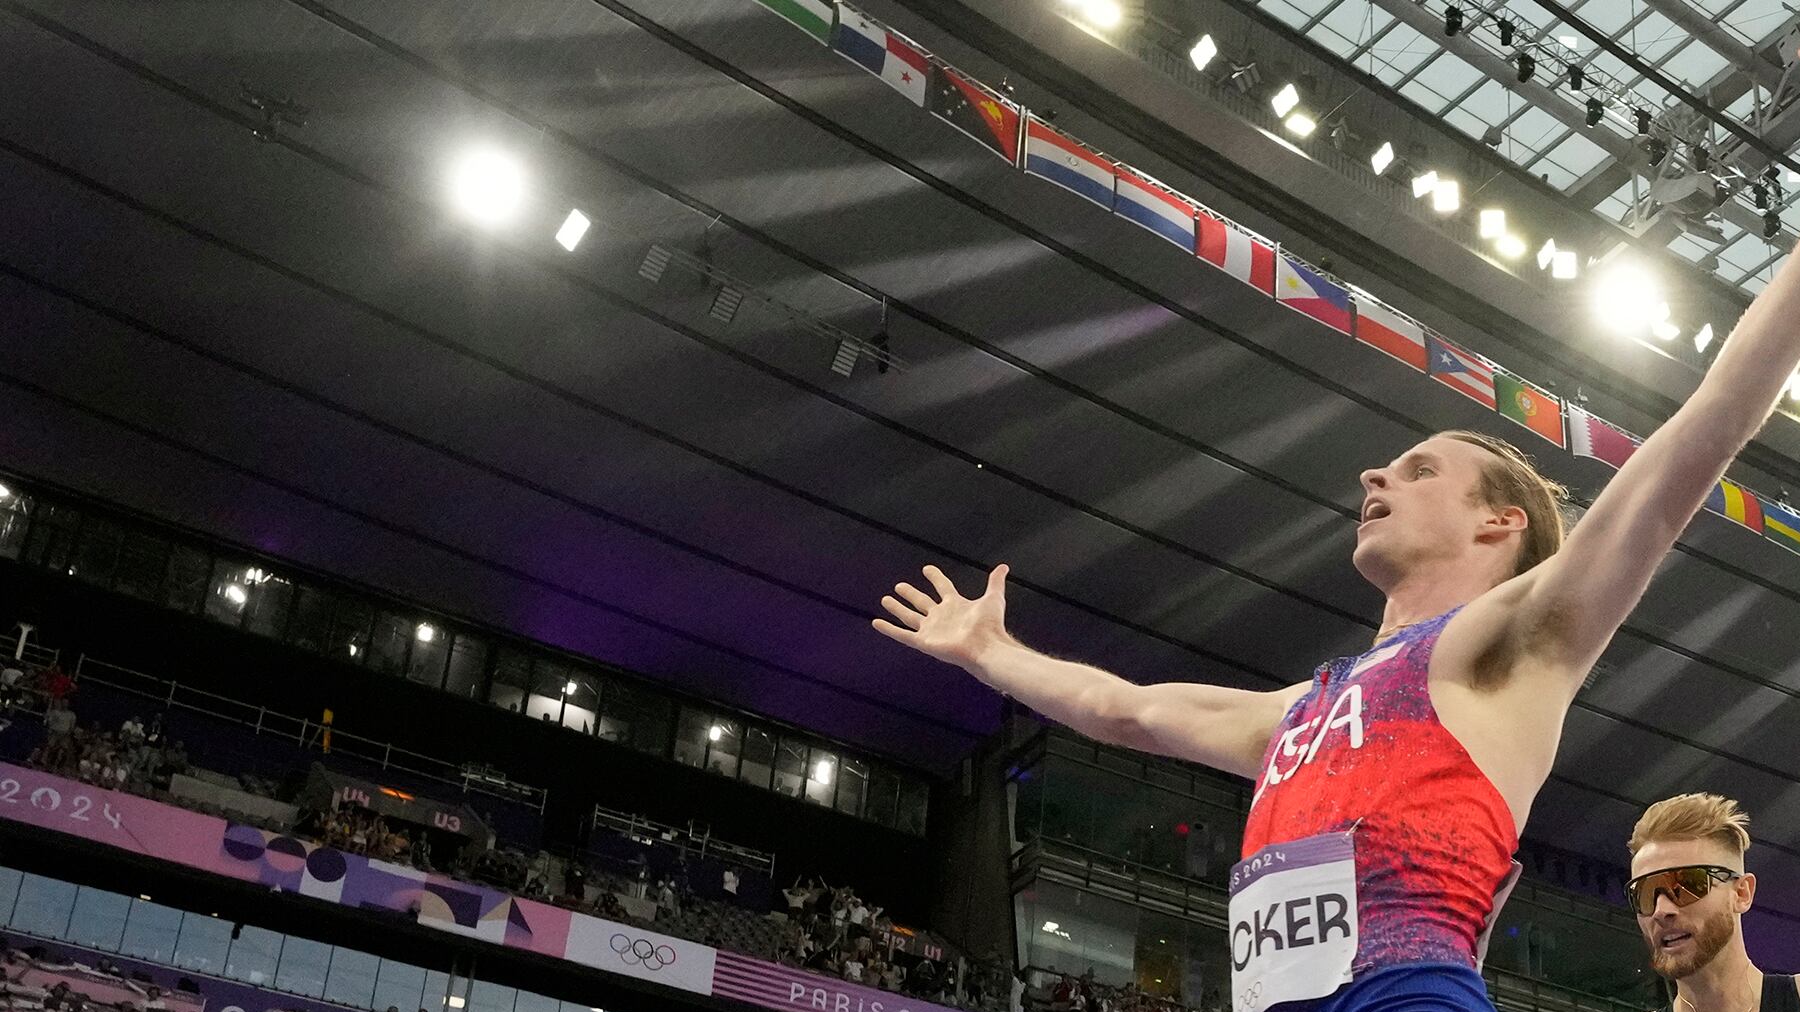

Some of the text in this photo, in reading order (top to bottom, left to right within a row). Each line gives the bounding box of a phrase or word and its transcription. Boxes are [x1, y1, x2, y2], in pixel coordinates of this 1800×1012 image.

[0, 778, 122, 830] 2024
[434, 811, 461, 832] U3
[1243, 851, 1286, 879] 2024
[1232, 893, 1351, 972] CKER
